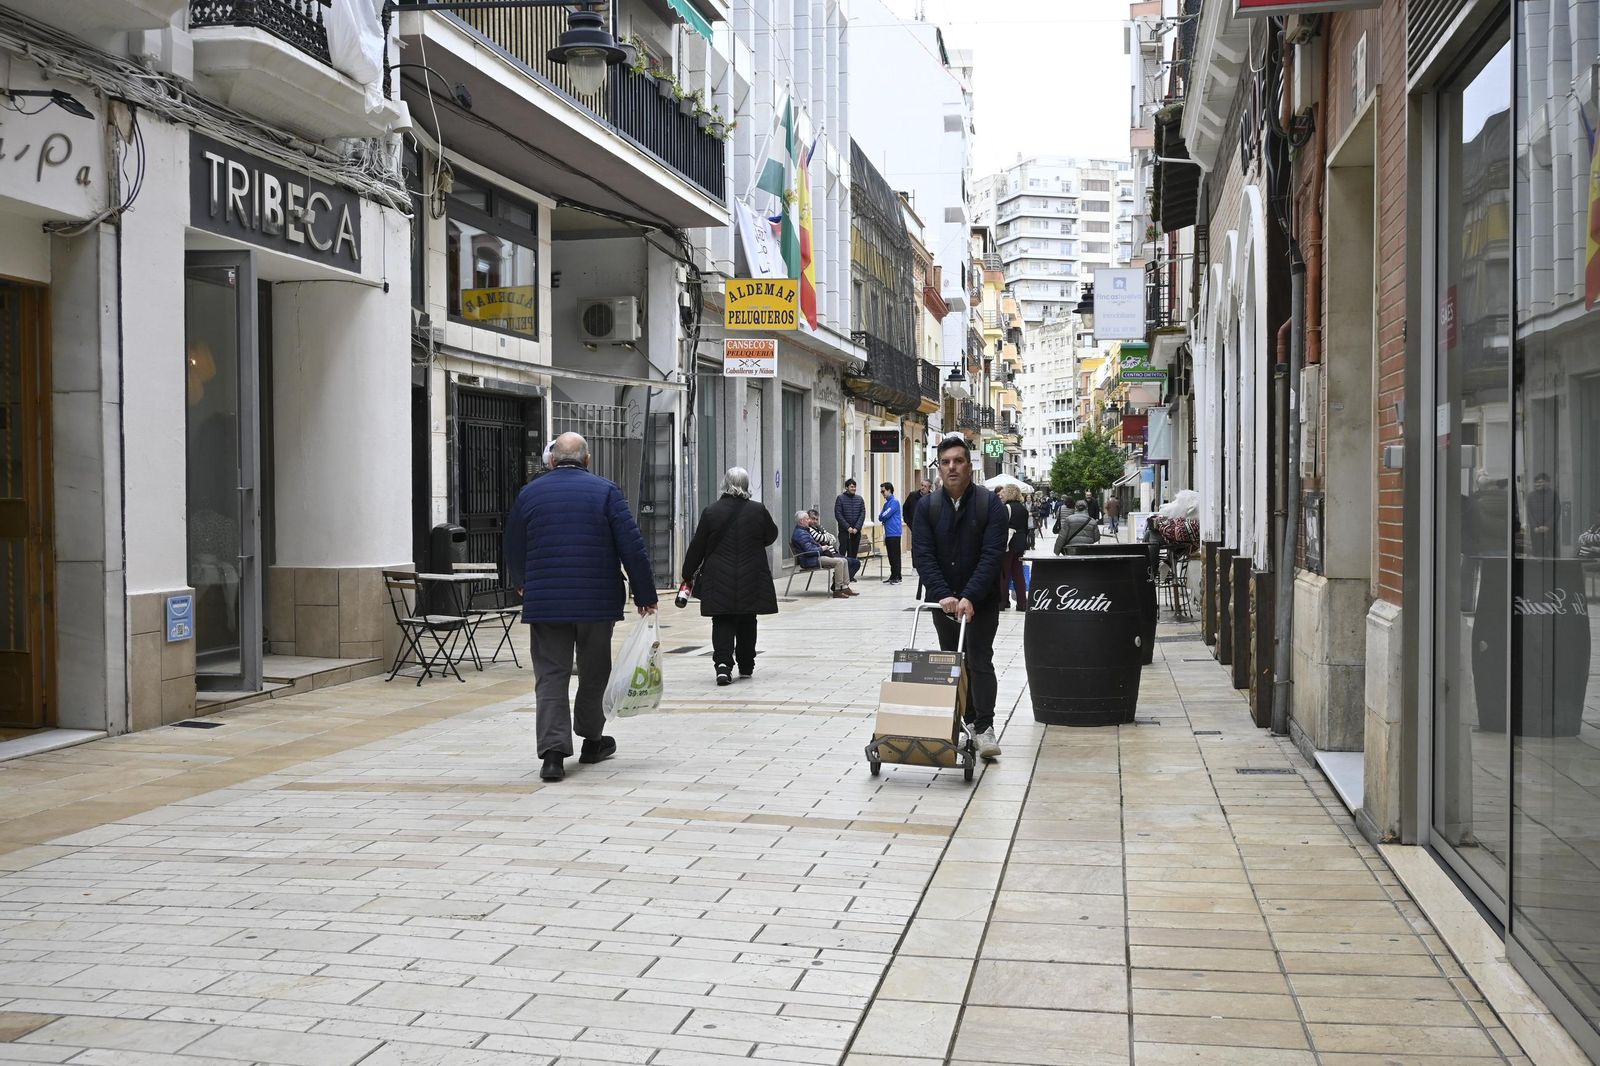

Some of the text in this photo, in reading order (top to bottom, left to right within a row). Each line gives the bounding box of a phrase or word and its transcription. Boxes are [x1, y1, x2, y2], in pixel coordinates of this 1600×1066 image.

[202, 150, 358, 261] TRIBECA
[728, 282, 796, 304] ALDEMAR
[728, 310, 795, 325] PELUQUEROS
[726, 350, 775, 358] PELUQUERIA
[1030, 584, 1113, 613] La Guita
